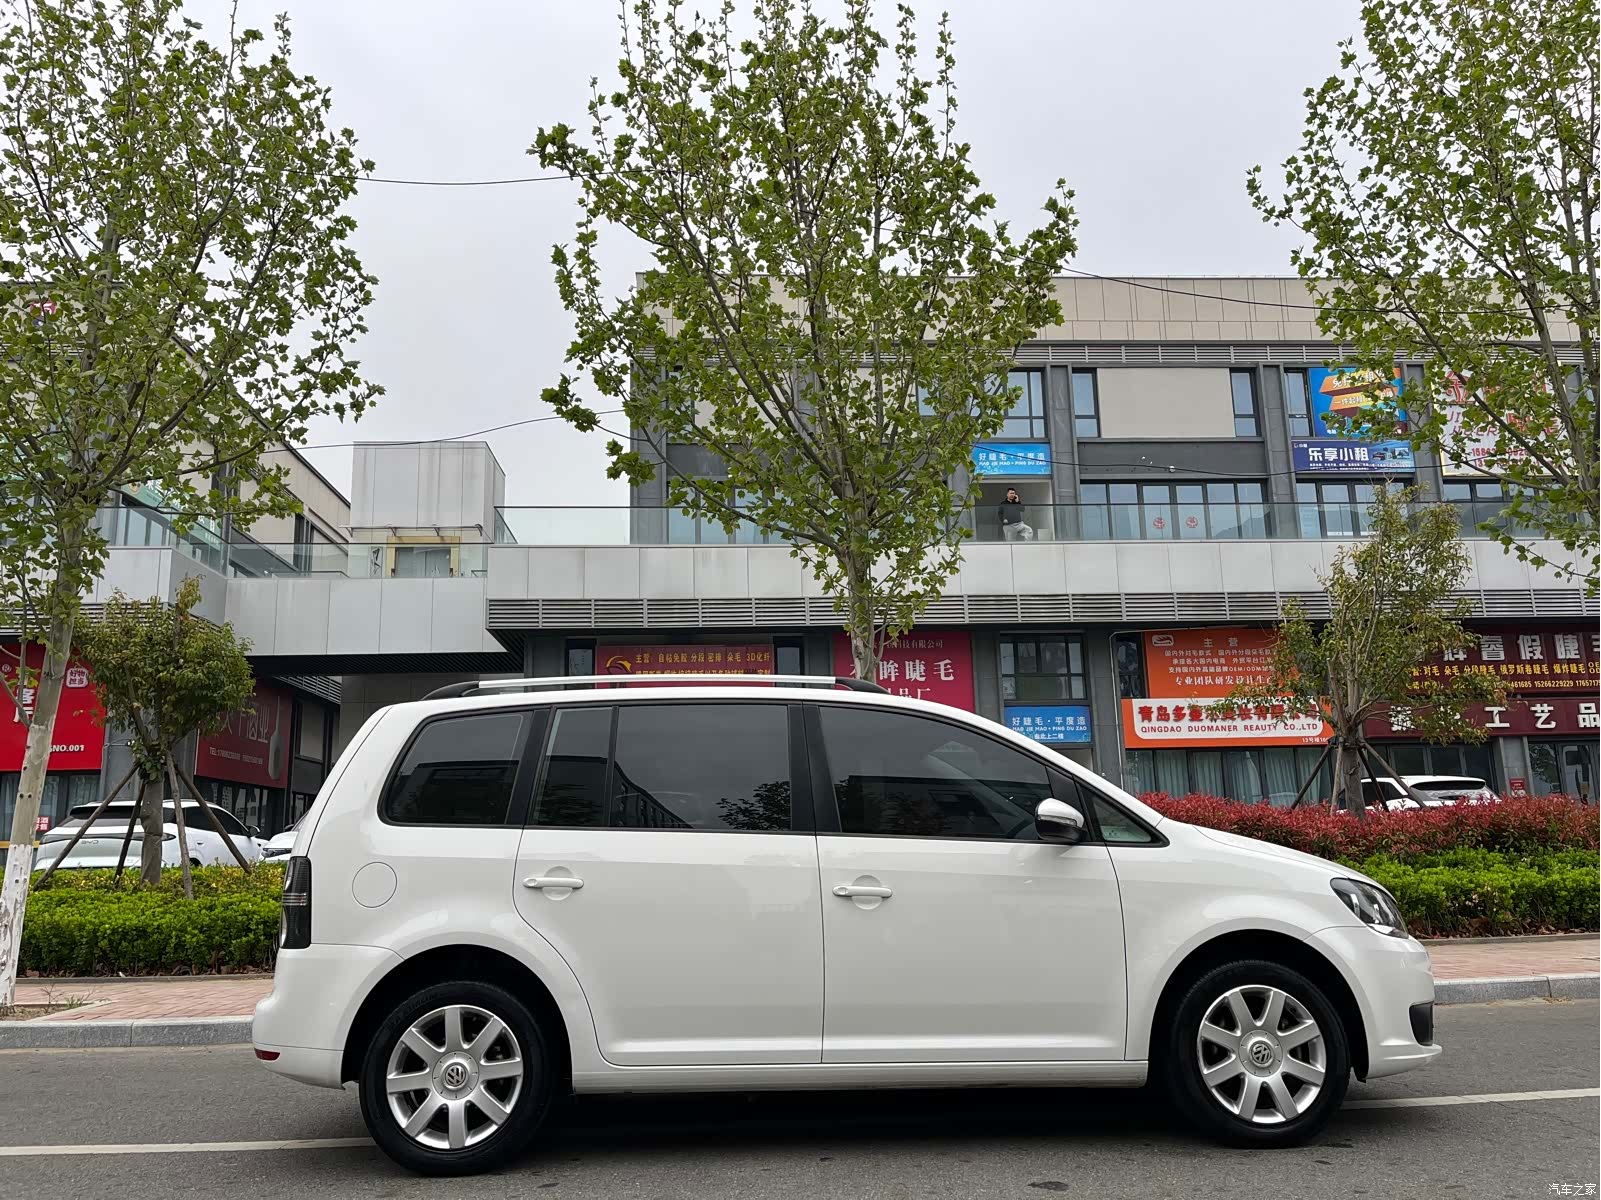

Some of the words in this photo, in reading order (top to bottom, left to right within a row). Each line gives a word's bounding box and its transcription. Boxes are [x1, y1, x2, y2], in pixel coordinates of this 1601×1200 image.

[1308, 447, 1370, 461] 乐享小租
[849, 659, 955, 682] 眸睫毛
[1141, 725, 1182, 733] QINGDAO
[1188, 724, 1238, 732] DUOMANER
